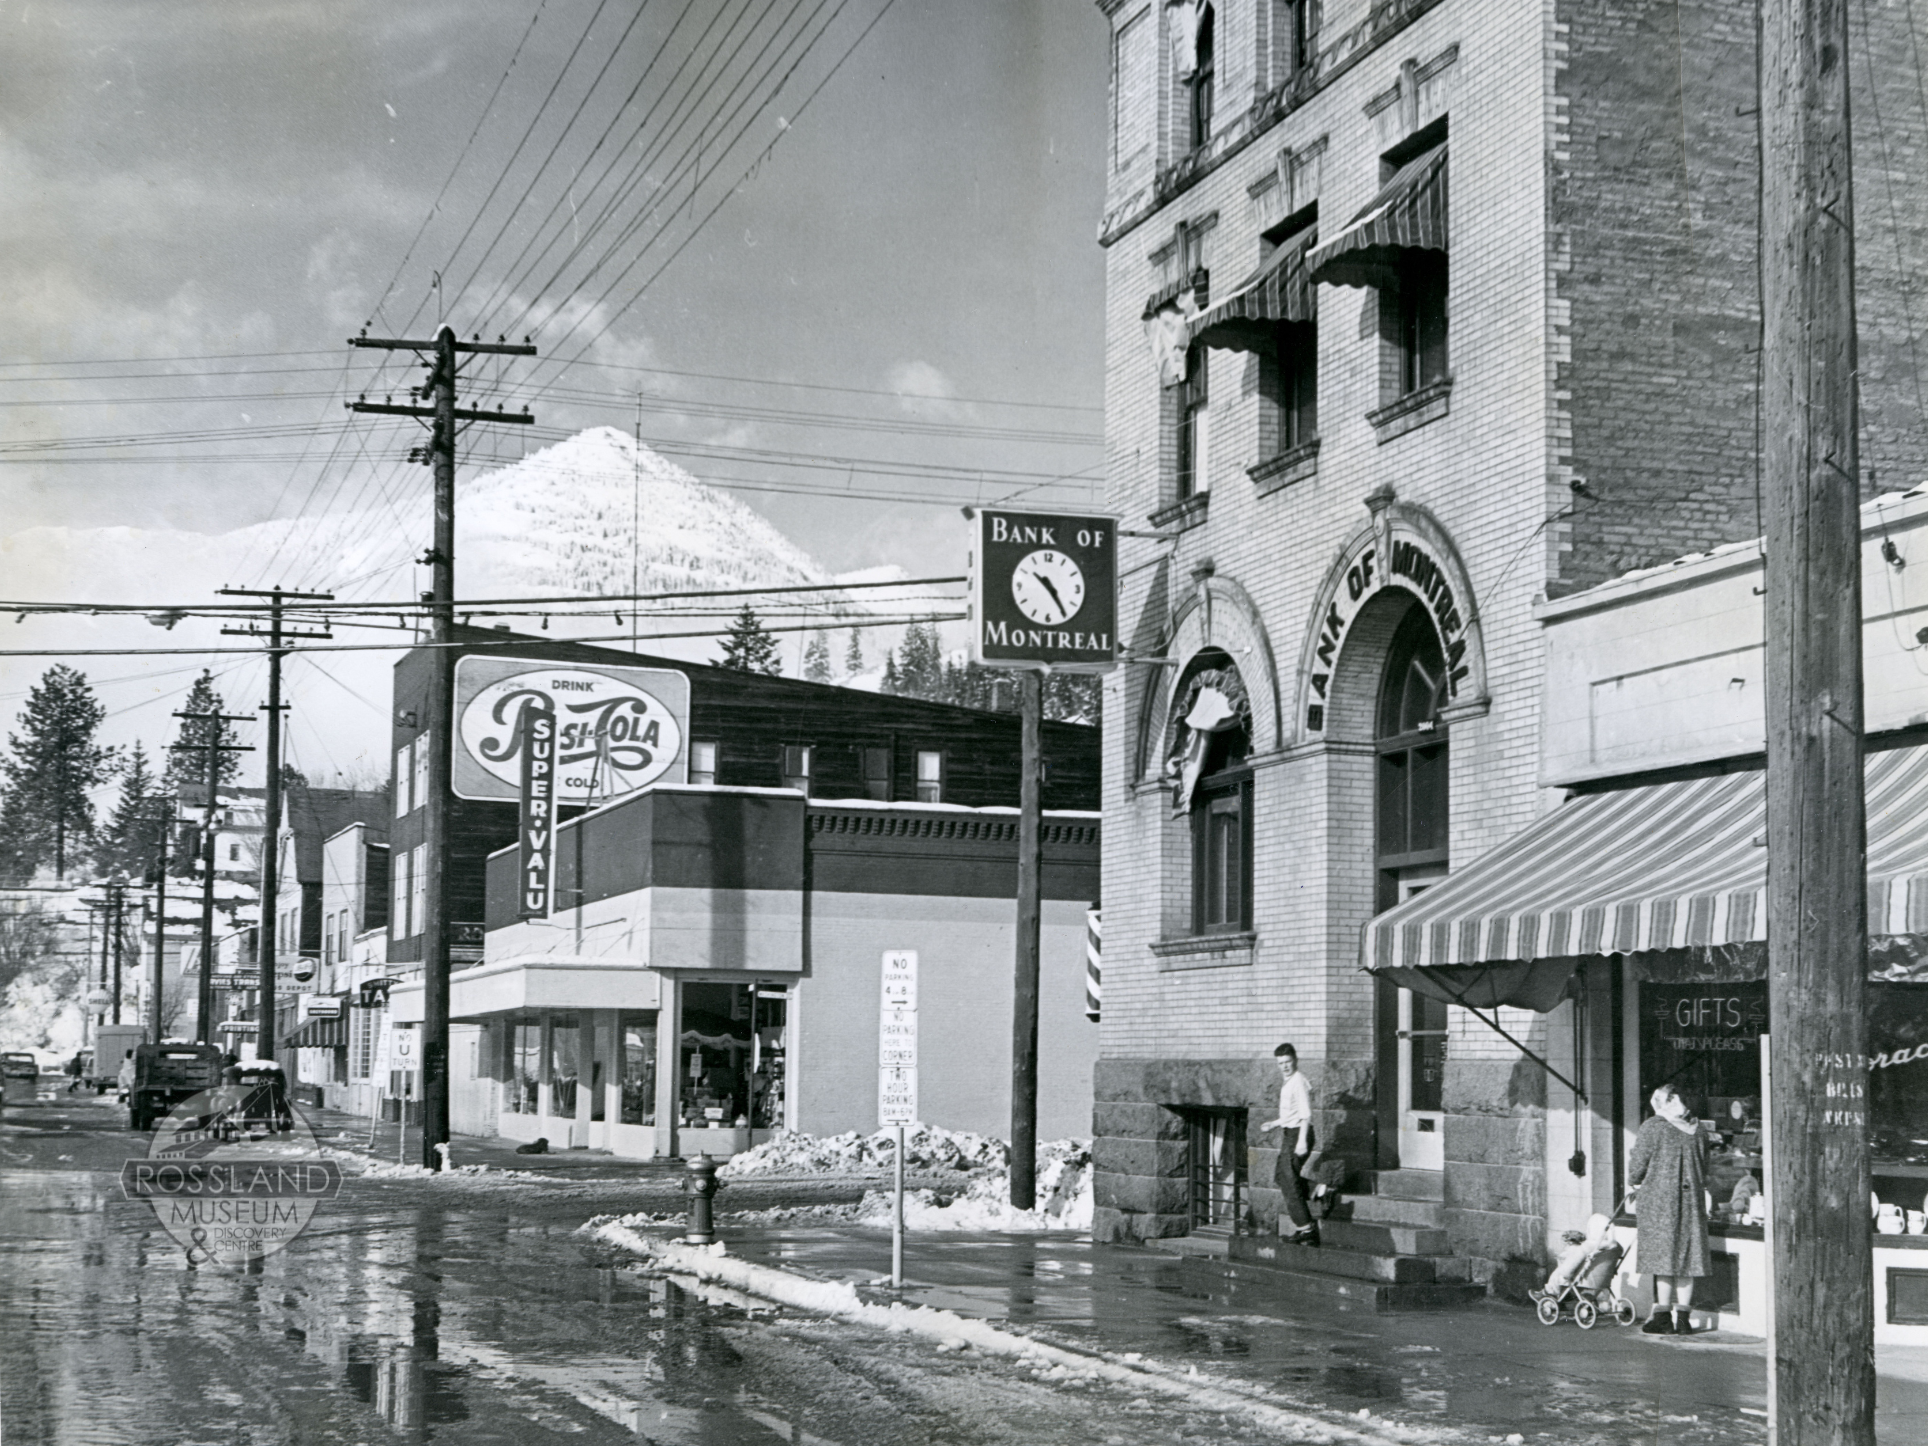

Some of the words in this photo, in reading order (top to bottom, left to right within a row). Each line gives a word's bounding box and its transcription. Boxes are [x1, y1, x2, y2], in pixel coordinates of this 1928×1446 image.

[1043, 552, 1054, 563] 12
[1016, 581, 1023, 591] 9
[1074, 584, 1081, 595] 3
[1045, 613, 1052, 623] 6
[1306, 601, 1345, 732] BANK
[1346, 548, 1377, 602] OF
[1390, 539, 1470, 698] MONTREAL
[551, 679, 594, 693] DRINK
[565, 777, 599, 788] COLD
[893, 958, 907, 970] NO
[884, 973, 914, 982] PARKING
[362, 989, 389, 1003] TA
[885, 986, 891, 994] 4
[901, 986, 907, 995] 8
[894, 1011, 904, 1022] NO
[1676, 998, 1741, 1027] GIFTS
[883, 1024, 915, 1036] PARKING
[398, 1034, 412, 1042] NO
[399, 1044, 411, 1056] U
[883, 1049, 914, 1061] CORNER
[392, 1058, 418, 1066] TURN
[889, 1070, 907, 1082] TWO
[887, 1082, 909, 1093] HOUR
[882, 1094, 914, 1106] PARKING
